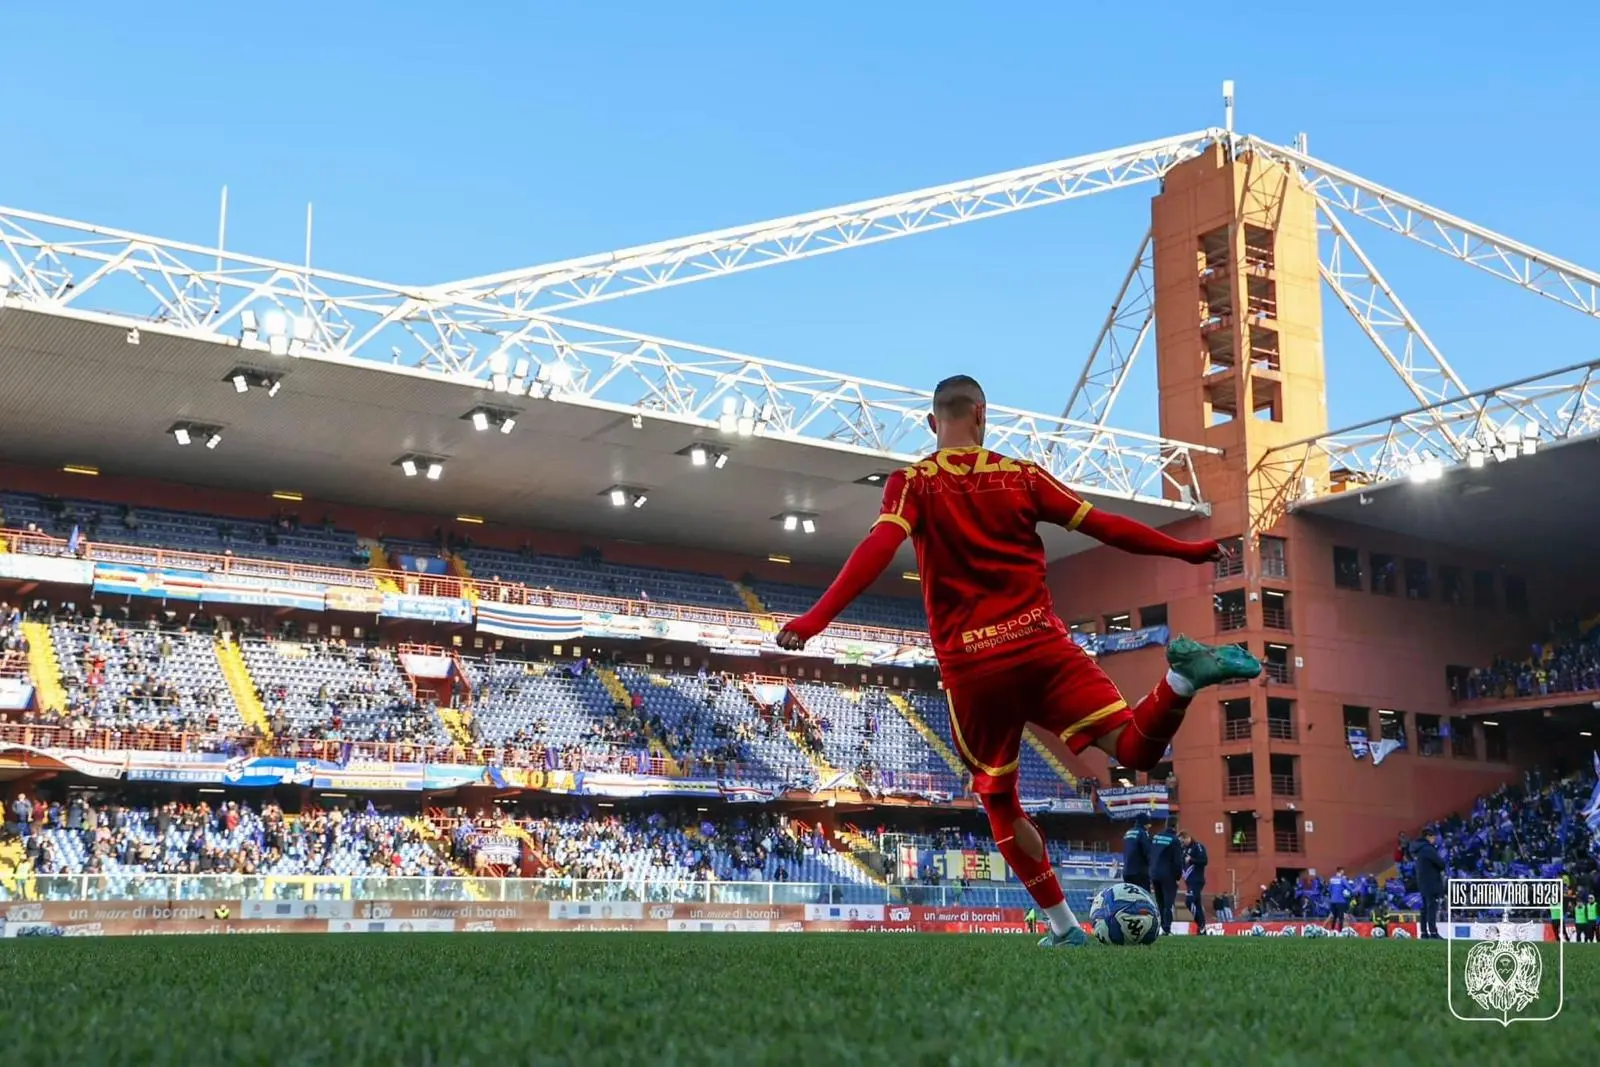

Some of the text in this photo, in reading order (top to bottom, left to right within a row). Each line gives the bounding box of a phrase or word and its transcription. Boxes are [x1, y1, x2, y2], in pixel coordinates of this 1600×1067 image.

[68, 908, 88, 919] un
[132, 906, 147, 919] di
[412, 908, 427, 918] un
[460, 907, 473, 918] di
[690, 909, 702, 919] un
[733, 908, 743, 919] di
[746, 908, 780, 920] borghi
[924, 912, 935, 920] un
[961, 911, 969, 921] di
[972, 911, 1000, 922] borghi
